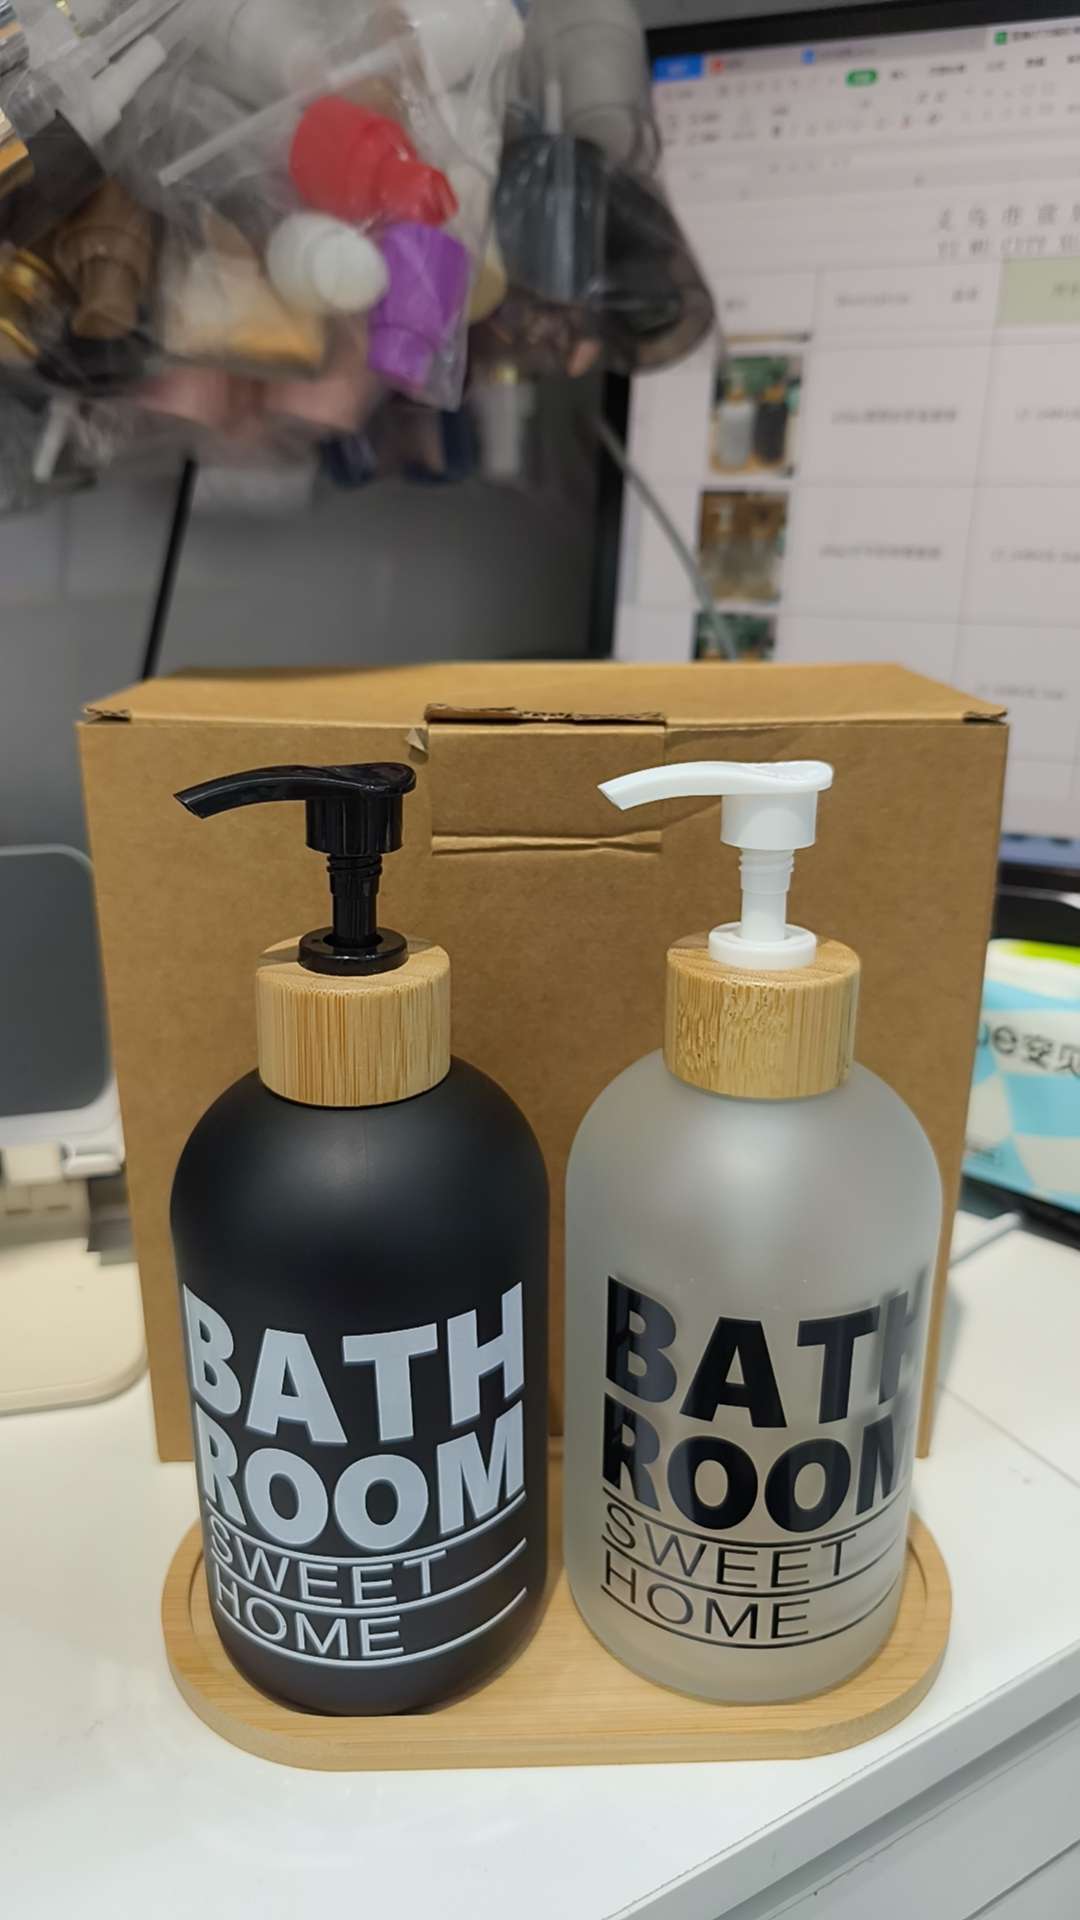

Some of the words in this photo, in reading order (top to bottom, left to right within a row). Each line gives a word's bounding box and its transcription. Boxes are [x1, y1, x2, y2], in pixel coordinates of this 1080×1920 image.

[182, 1281, 525, 1444] BATH
[194, 1400, 526, 1551] ROOM
[207, 1514, 447, 1607] SWEET
[604, 1502, 857, 1589] SWEET
[212, 1563, 405, 1657] HOME
[605, 1549, 811, 1639] HOME
